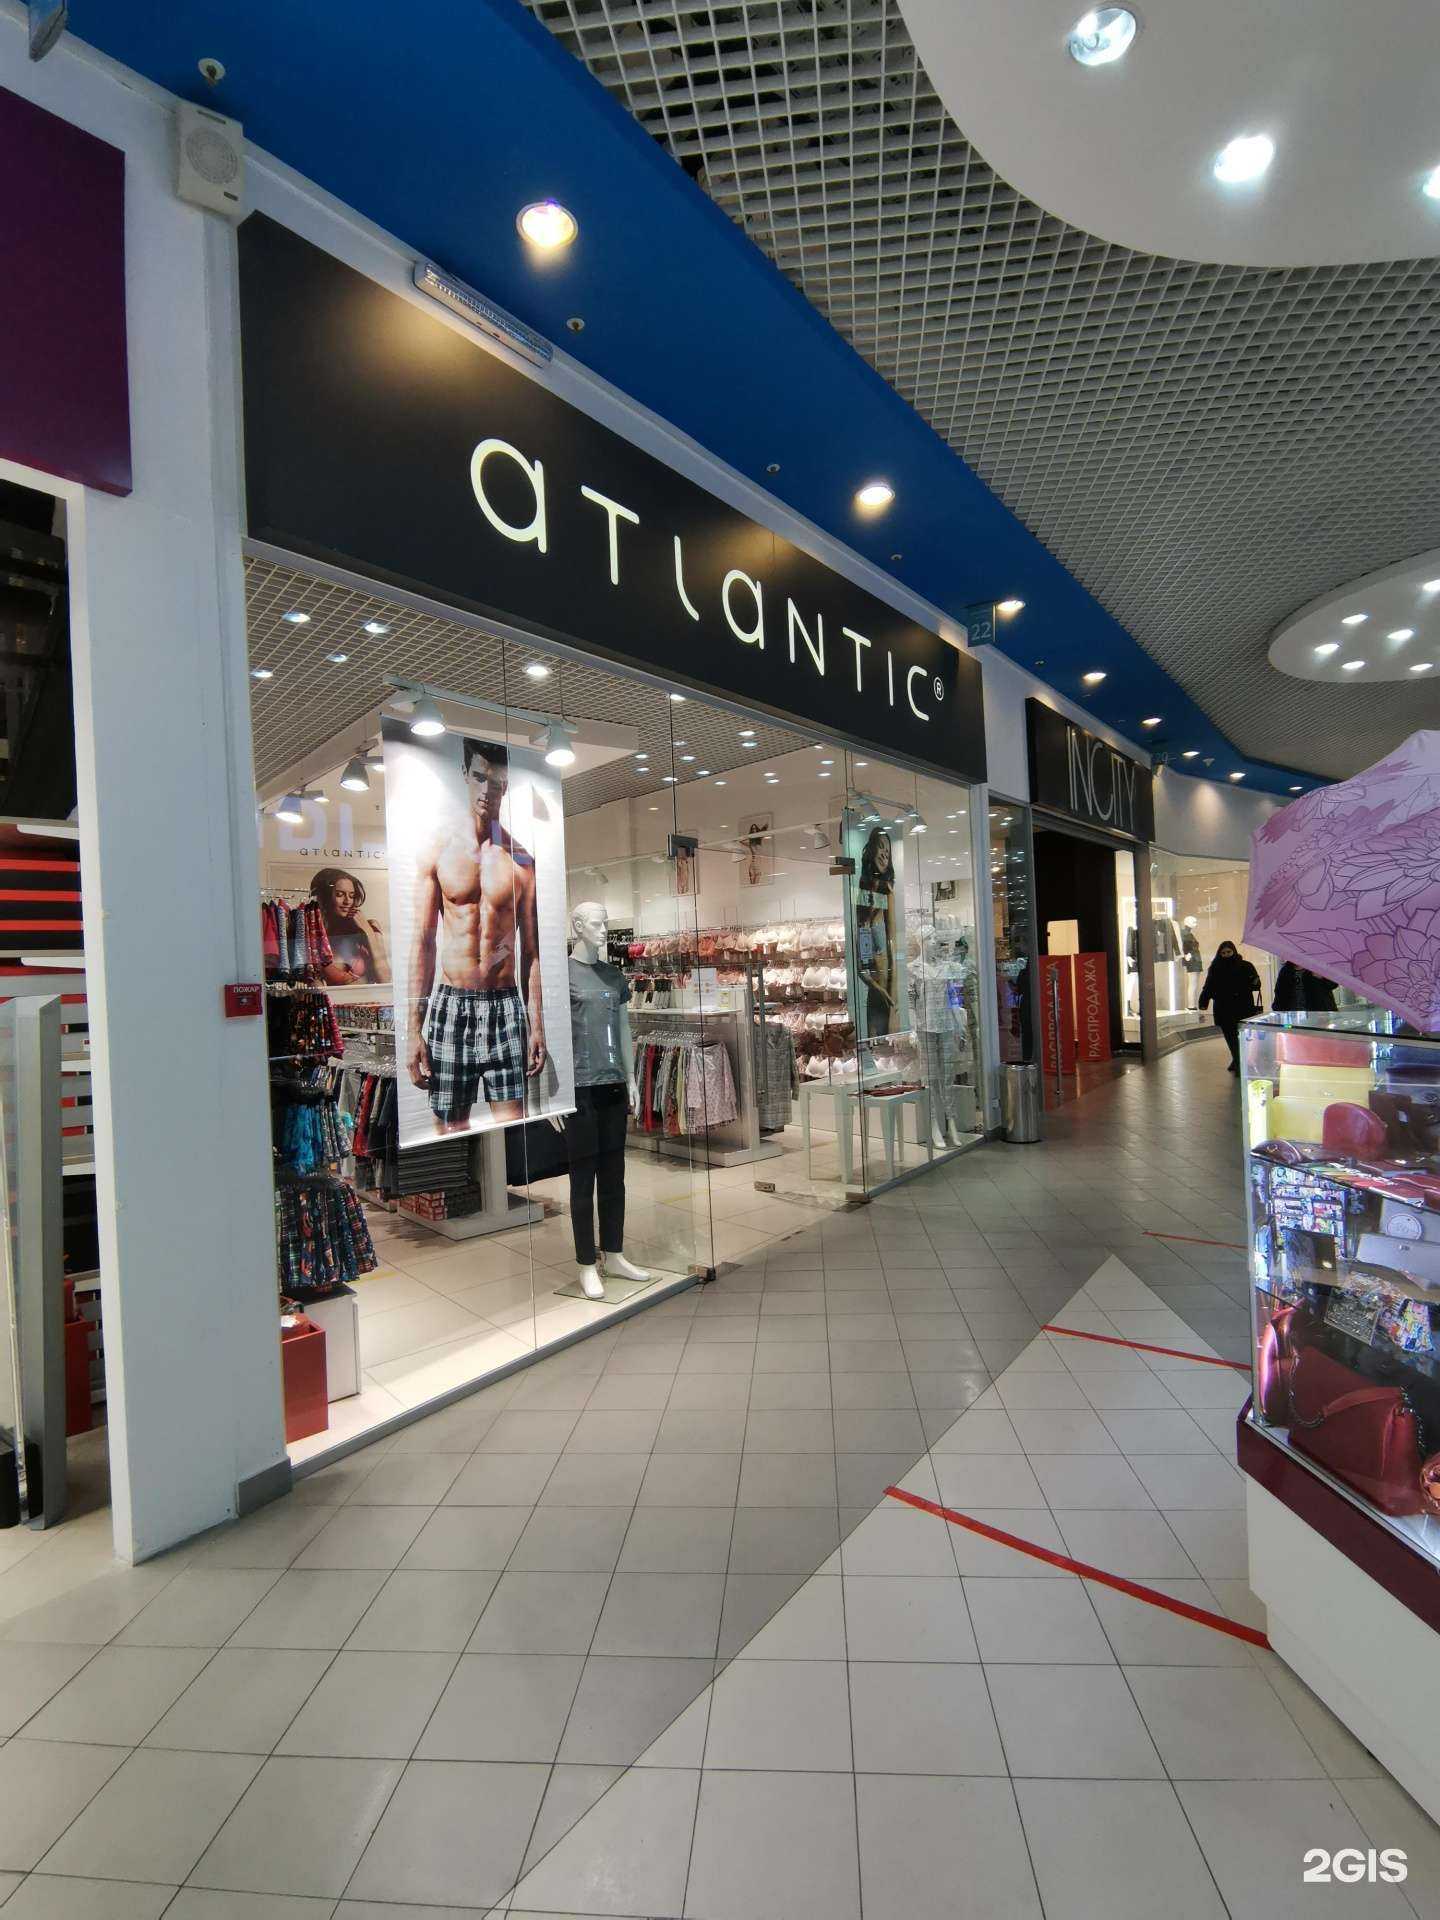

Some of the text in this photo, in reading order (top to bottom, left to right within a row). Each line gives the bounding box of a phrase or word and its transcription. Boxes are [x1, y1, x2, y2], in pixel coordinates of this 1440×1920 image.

[971, 621, 992, 640] 22
[1067, 725, 1136, 831] INCITY
[233, 984, 260, 993] ПОЖАР
[1083, 957, 1101, 1057] РАСПРОДАЖА
